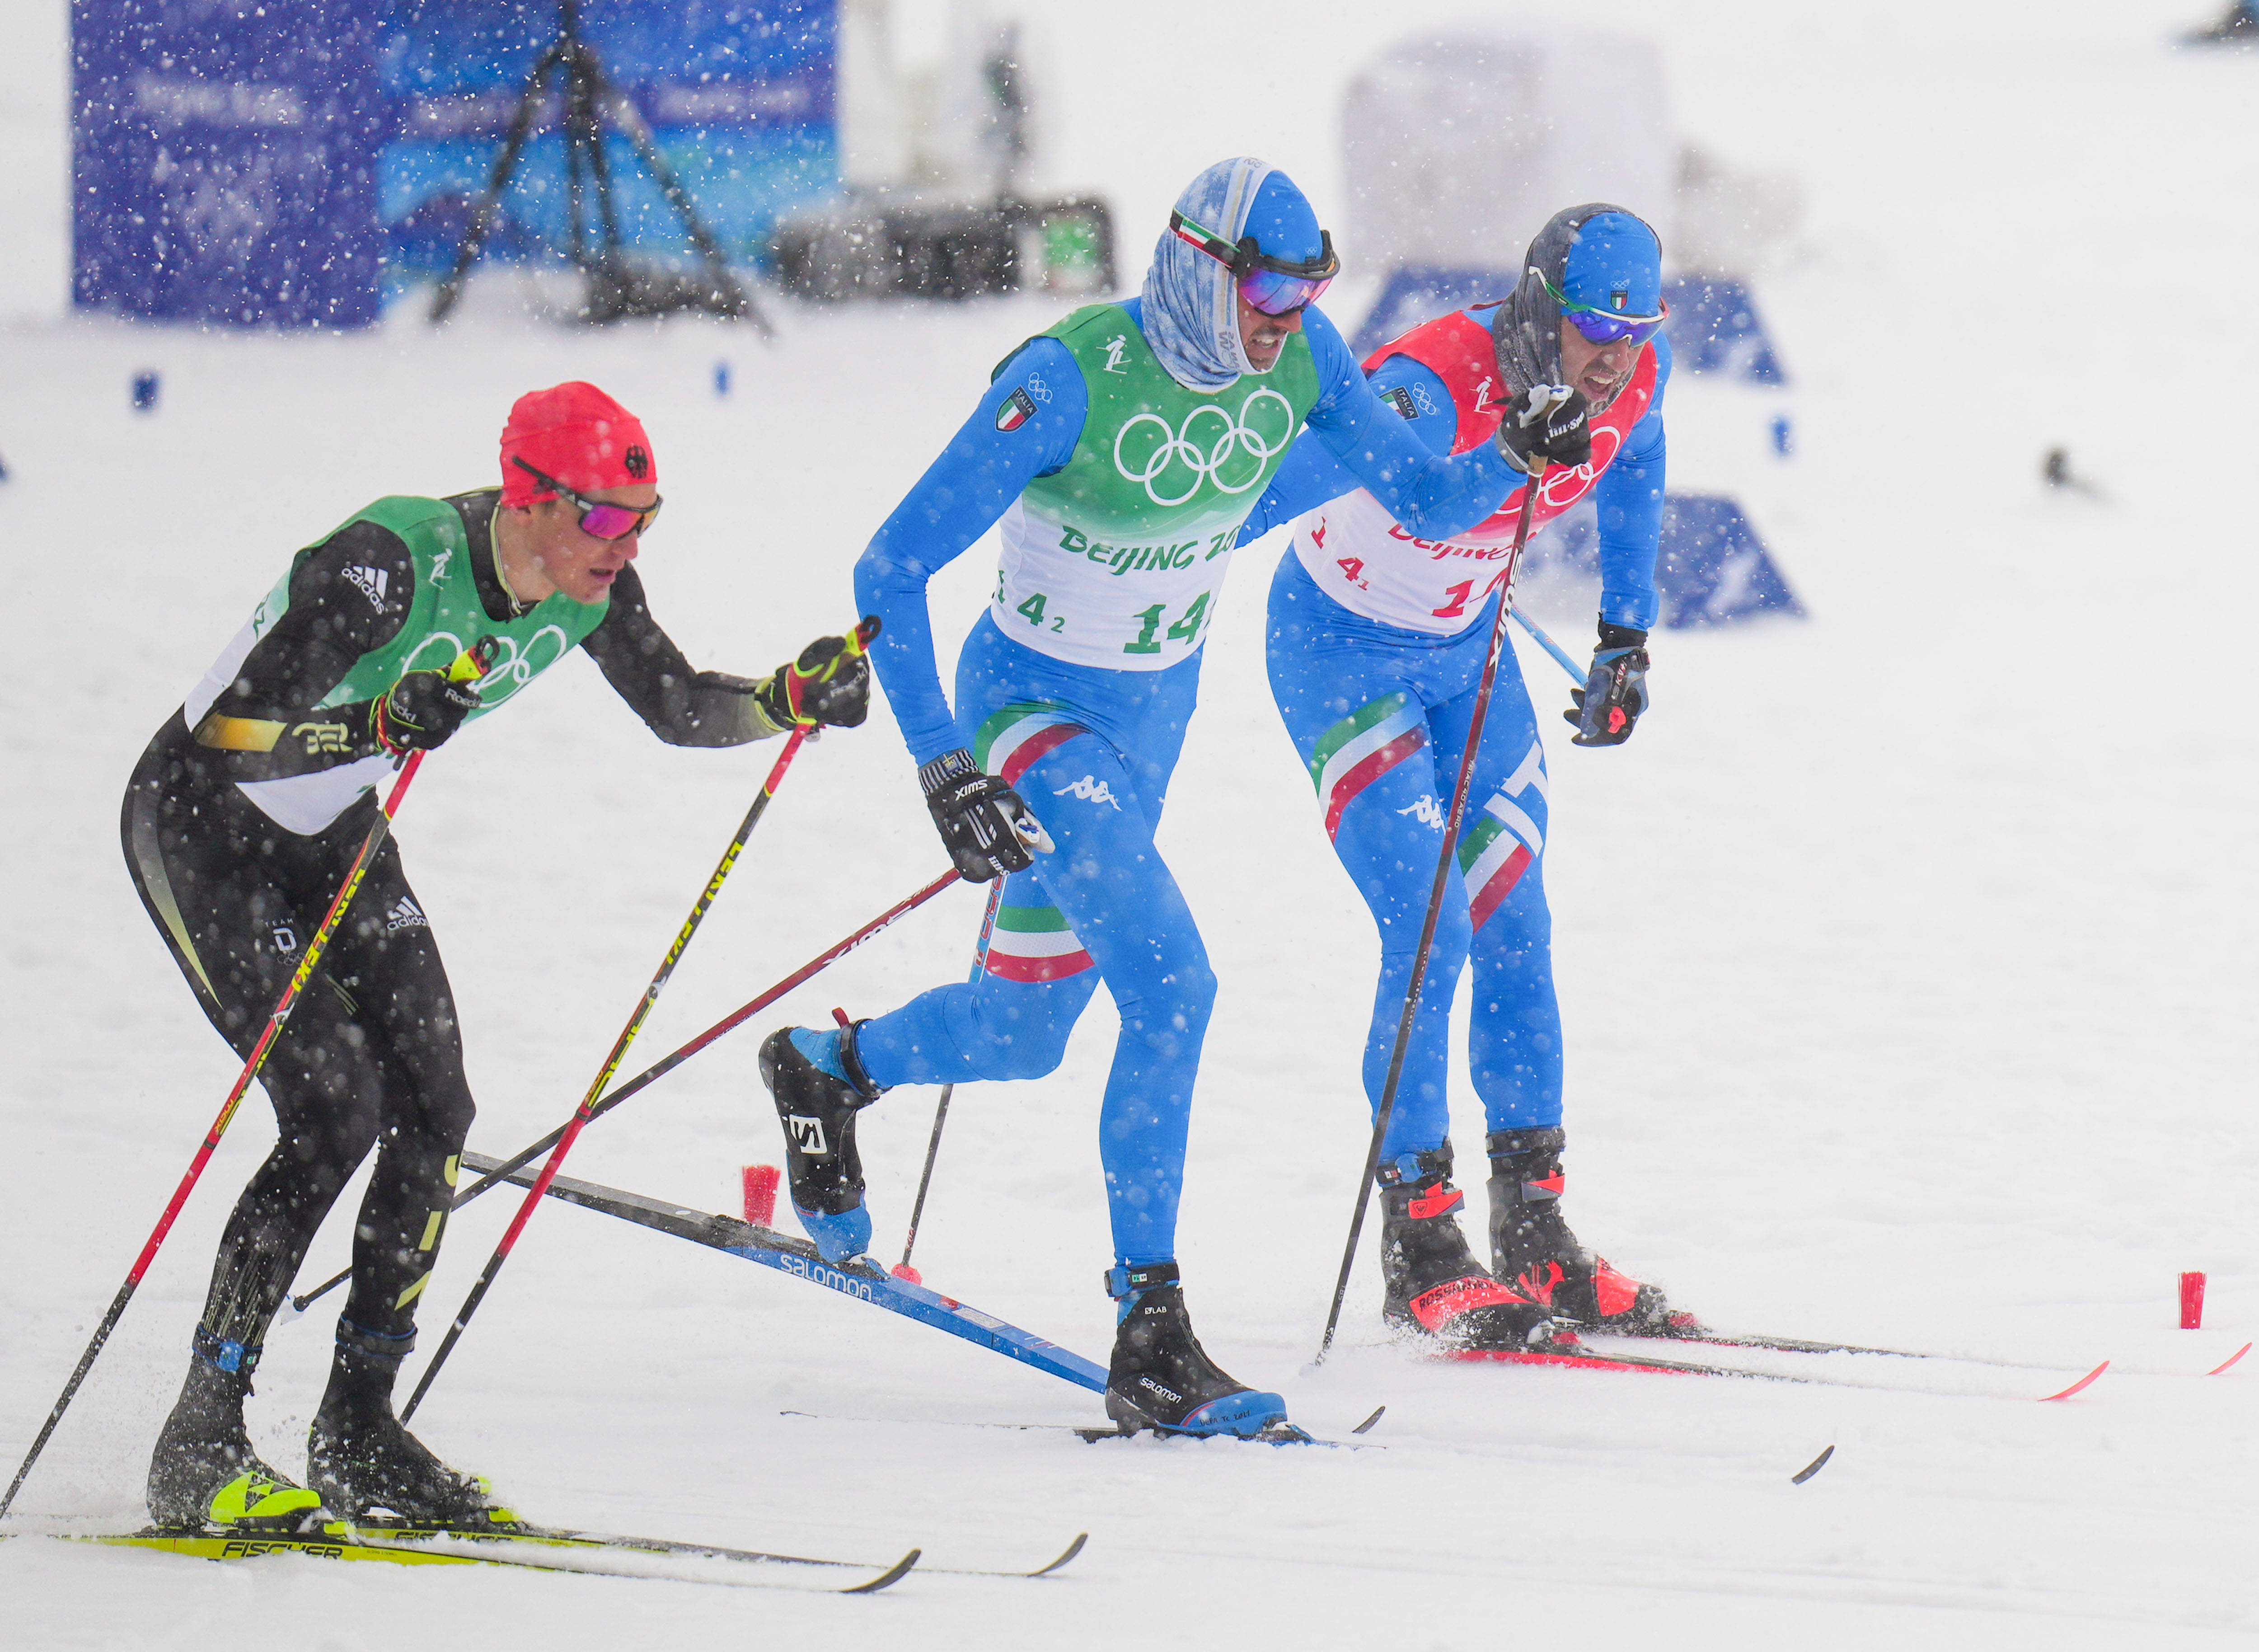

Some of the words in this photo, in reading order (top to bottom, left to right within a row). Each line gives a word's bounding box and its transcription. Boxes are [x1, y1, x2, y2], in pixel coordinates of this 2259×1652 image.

[1015, 389, 1033, 413] ITALIA
[1397, 389, 1414, 416] ITALIA
[1059, 525, 1198, 575] BEIJING
[342, 568, 384, 615] adidas
[955, 779, 988, 801] SWIX
[1454, 802, 1464, 828] AERO
[706, 841, 743, 901] LEKI
[332, 868, 366, 927] LEKI
[265, 917, 294, 928] TEAM
[387, 915, 430, 931] adida
[291, 928, 329, 992] LEKI
[780, 1254, 872, 1302] salomon
[1140, 1377, 1183, 1403] salomon
